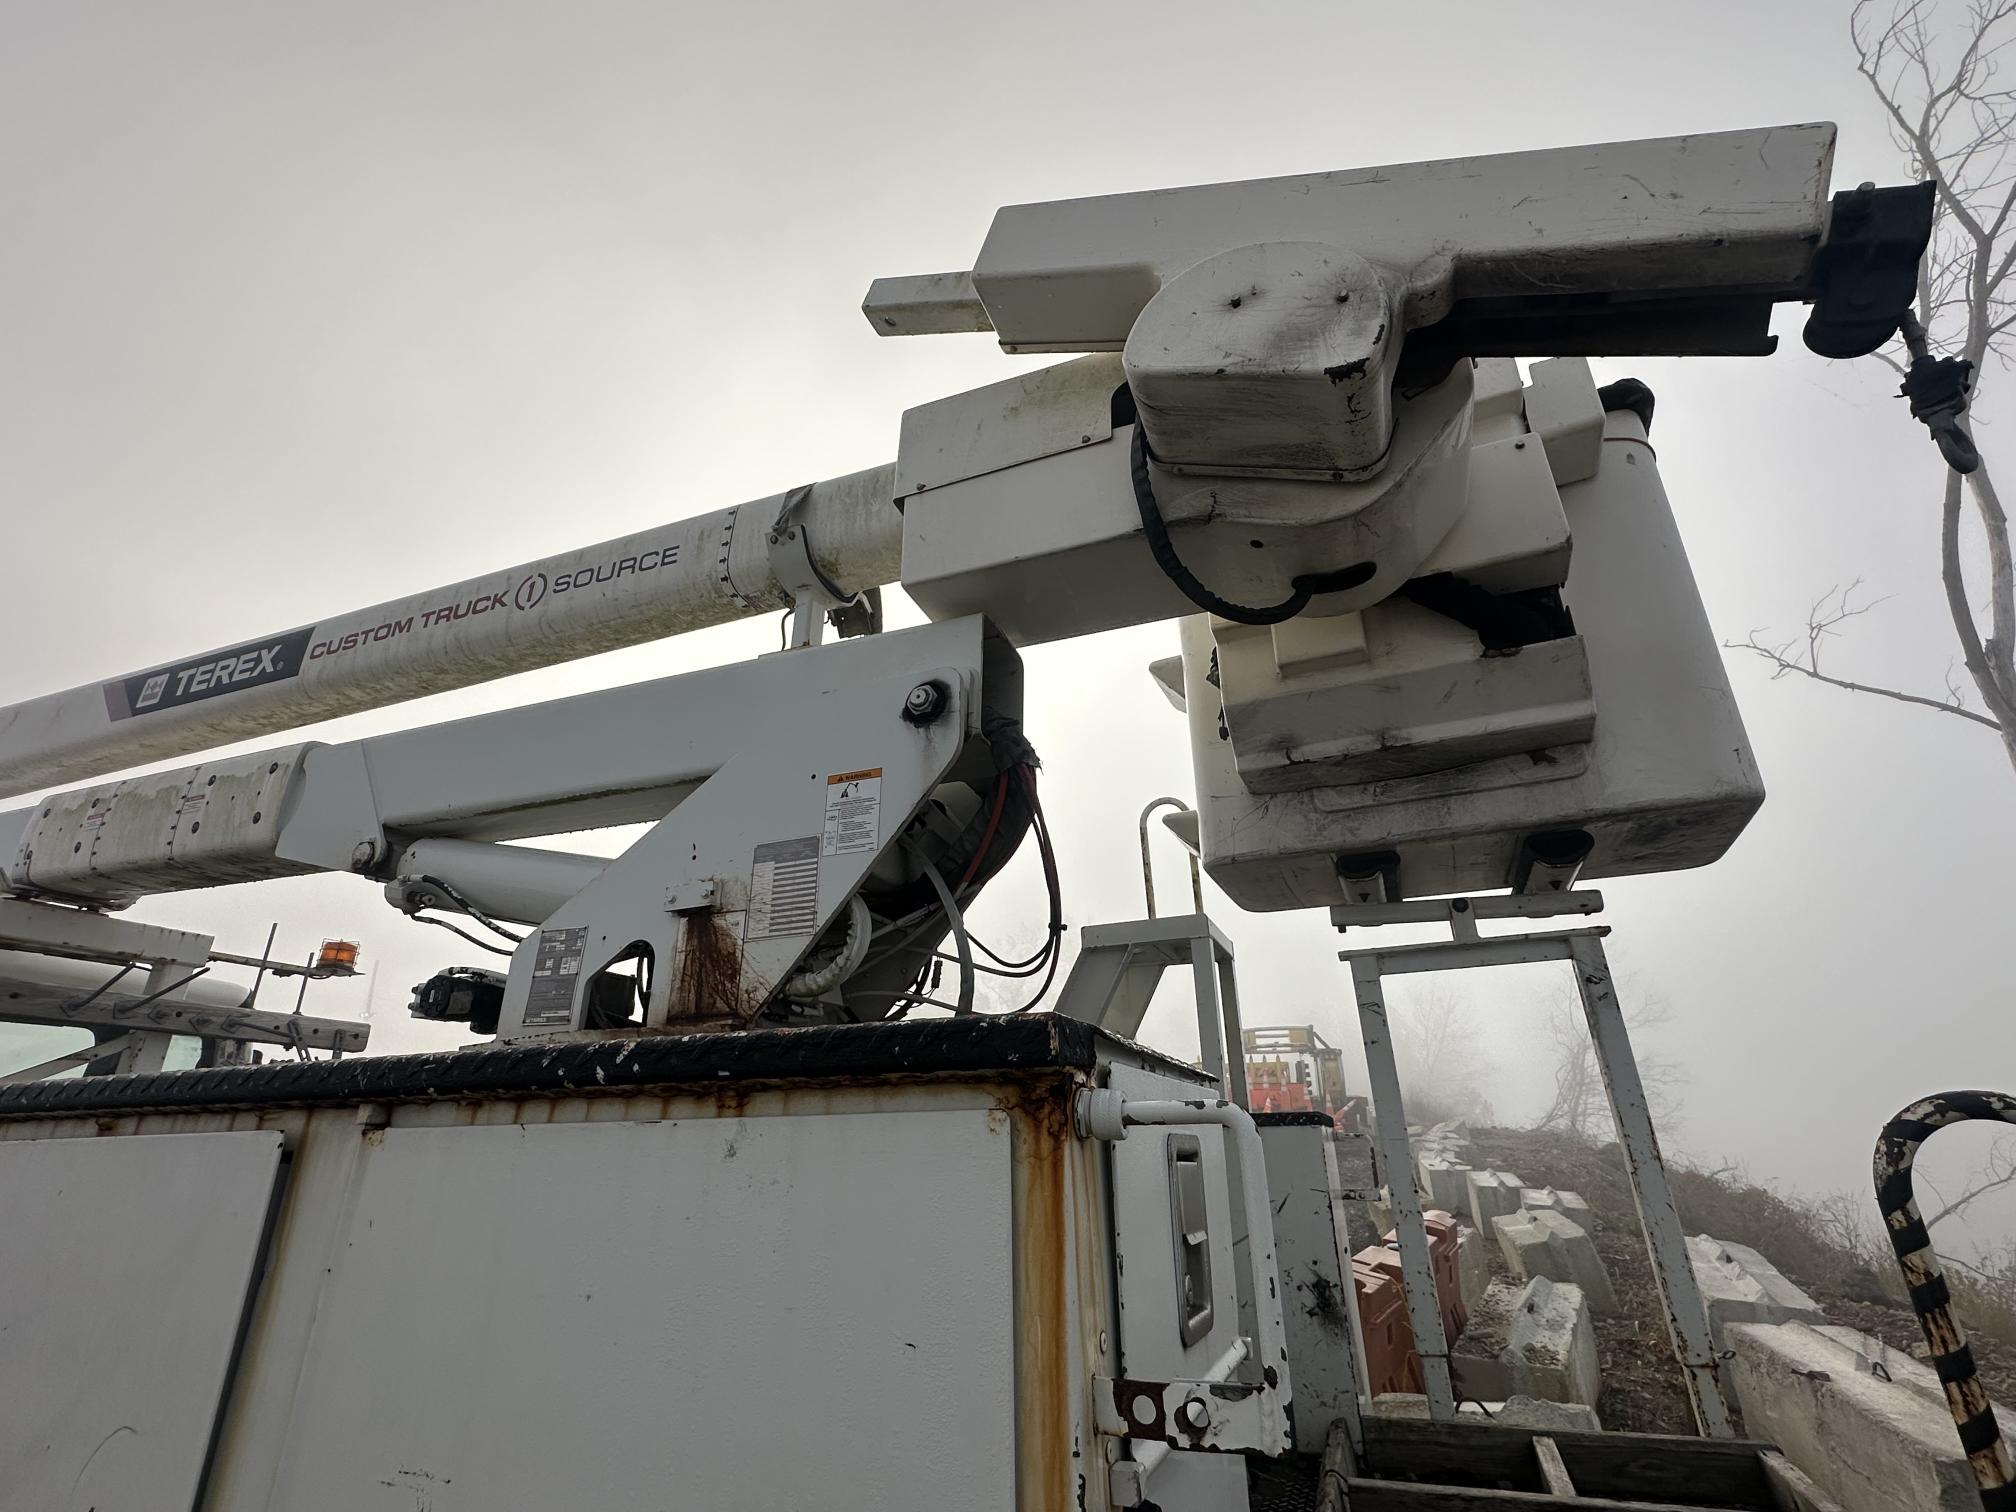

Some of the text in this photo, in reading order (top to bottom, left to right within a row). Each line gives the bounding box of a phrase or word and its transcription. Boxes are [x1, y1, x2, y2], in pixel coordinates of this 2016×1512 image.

[309, 616, 415, 660] CUSTOM
[421, 590, 511, 628] TRUCK
[552, 545, 680, 594] SOURCE
[176, 645, 282, 696] TEREX
